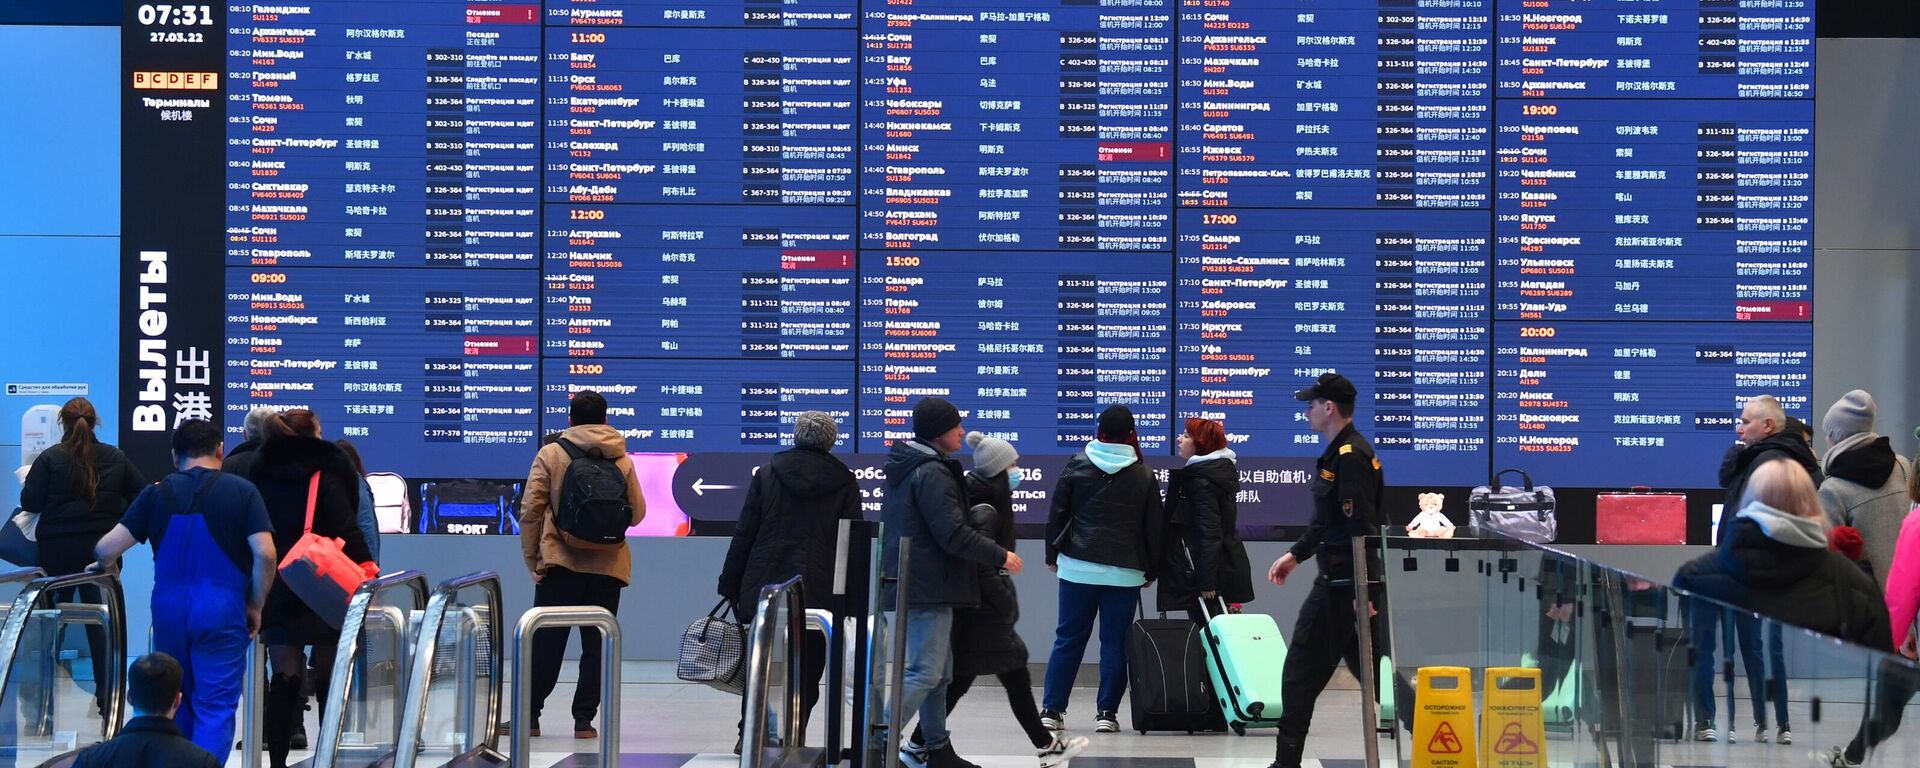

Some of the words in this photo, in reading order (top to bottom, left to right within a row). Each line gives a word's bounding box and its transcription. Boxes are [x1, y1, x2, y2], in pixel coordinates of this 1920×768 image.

[138, 5, 213, 25] 07:31
[253, 5, 310, 16] Геленджик
[571, 9, 623, 18] Мурманск
[1204, 13, 1229, 21] Сочи
[1523, 14, 1582, 23] Н.Новгород
[150, 32, 203, 42] 27.03.22
[252, 28, 316, 38] Архангельск
[572, 33, 605, 42] 11:00
[1204, 36, 1266, 44] Архангельск
[1523, 36, 1556, 44] Минск
[253, 50, 303, 59] Мин.Воды
[571, 53, 594, 62] Баку
[887, 55, 911, 64] Баку
[1522, 58, 1609, 68] Санкт-Петербург
[136, 74, 144, 83] B
[152, 74, 161, 83] C
[170, 74, 178, 83] D
[187, 74, 194, 83] E
[203, 74, 210, 84] F
[253, 72, 296, 81] Грозный
[570, 75, 595, 84] Орск
[886, 77, 906, 87] Уфа
[252, 94, 293, 102] Тюмень
[142, 97, 210, 109] Терминалы
[887, 100, 942, 109] Чебоксары
[1204, 102, 1270, 111] Калининград
[1523, 106, 1556, 115] 19:00
[160, 110, 193, 121] 候机楼
[252, 116, 277, 124] Сочи
[887, 122, 951, 130] Нижнекамск
[1203, 124, 1243, 133] Саратов
[1522, 125, 1578, 135] Череповец
[252, 138, 338, 148] Санкт-Петербург
[570, 141, 618, 151] Салехард
[887, 144, 919, 152] Минск
[252, 160, 285, 168] Минск
[1521, 169, 1576, 177] Челябинск
[569, 185, 617, 194] Абу-Даби
[252, 205, 307, 213] Махачкала
[571, 210, 604, 219] 12:00
[1204, 215, 1236, 224] 17:00
[250, 227, 277, 235] Сочи
[569, 230, 621, 239] Астрахань
[886, 232, 938, 242] Волгоград
[1202, 235, 1240, 244] Самара
[1521, 236, 1580, 246] Красноярск
[251, 249, 311, 259] Ставрополь
[570, 252, 612, 260] Нальчик
[887, 257, 919, 266] 15:00
[251, 274, 286, 283] 09:00
[781, 277, 830, 285] Регистрация
[885, 276, 923, 286] Самара
[1521, 281, 1564, 289] Магадан
[569, 296, 591, 304] Ухта
[885, 298, 918, 307] Пермь
[1201, 300, 1256, 310] Хабаровск
[1520, 303, 1567, 312] Улан-Удэ
[251, 315, 318, 325] Новосибирск
[568, 318, 611, 326] Апатиты
[1202, 323, 1242, 332] Иркутск
[1521, 328, 1555, 337] 20:00
[132, 251, 167, 431] Вылеты
[251, 337, 282, 345] Пенза
[569, 340, 604, 348] Казань
[885, 343, 956, 352] Магнитогорск
[1520, 347, 1587, 357] Калининград
[570, 365, 603, 374] 13:00
[885, 365, 936, 374] Мурманск
[1520, 369, 1546, 378] Дели
[172, 346, 213, 430] 出港
[1201, 389, 1253, 398] Мурманск
[1201, 411, 1226, 419] Доха
[1520, 436, 1578, 445] Н.Новгород
[1236, 469, 1312, 484] 以自助值机，
[447, 523, 488, 535] SPORT
